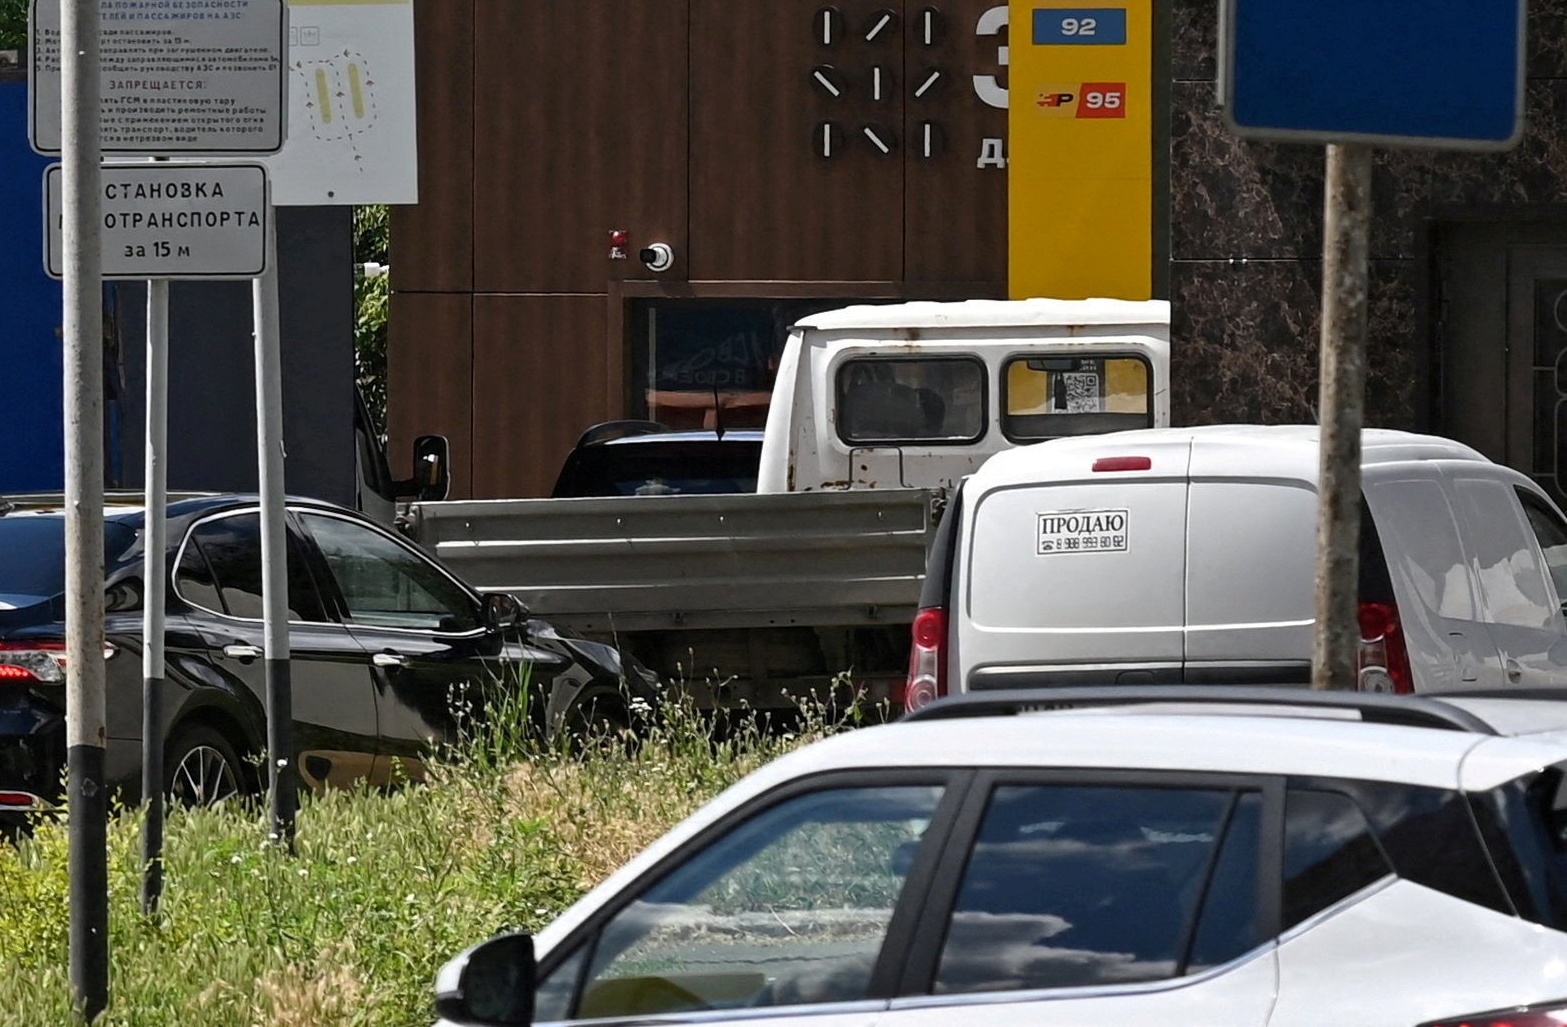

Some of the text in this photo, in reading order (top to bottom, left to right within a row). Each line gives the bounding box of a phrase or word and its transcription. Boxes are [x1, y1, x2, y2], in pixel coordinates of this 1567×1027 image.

[172, 0, 249, 9] БЕЗОПАСНОСТИ
[137, 12, 205, 20] ПАССАЖИРОВ
[1061, 18, 1096, 35] 92
[109, 80, 207, 91] ЗАПРЕЩАЕТСЯ:
[1086, 92, 1121, 109] 95
[105, 181, 224, 200] СТАНОВКА
[59, 211, 260, 229] ОТРАНСПОРТА
[124, 242, 191, 258] за 15 м
[1042, 514, 1125, 536] ПРОДАЮ
